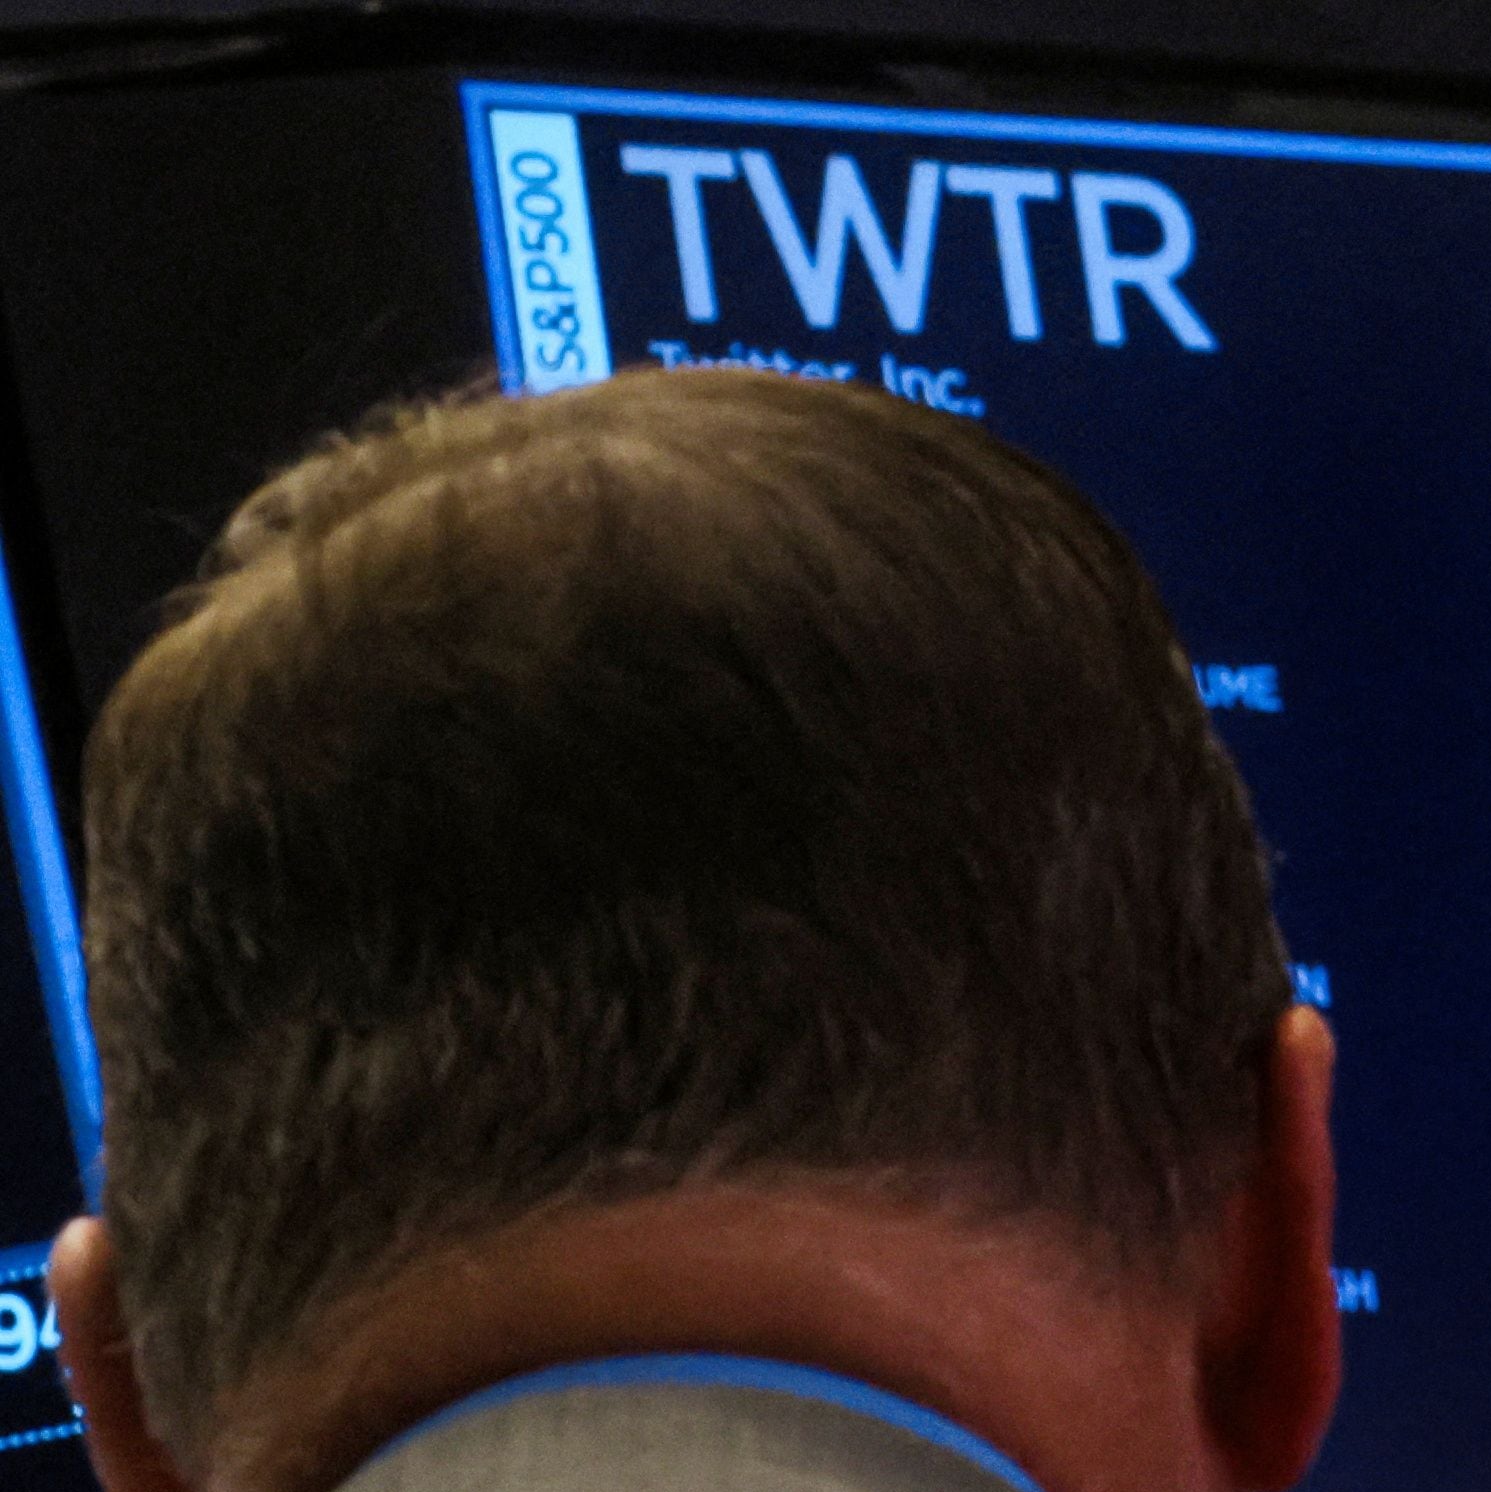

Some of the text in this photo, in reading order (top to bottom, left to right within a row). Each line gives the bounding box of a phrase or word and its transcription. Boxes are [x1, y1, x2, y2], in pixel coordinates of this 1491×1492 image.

[510, 150, 587, 374] S&P500
[619, 142, 1219, 354] TWTR
[880, 352, 986, 418] Inc.
